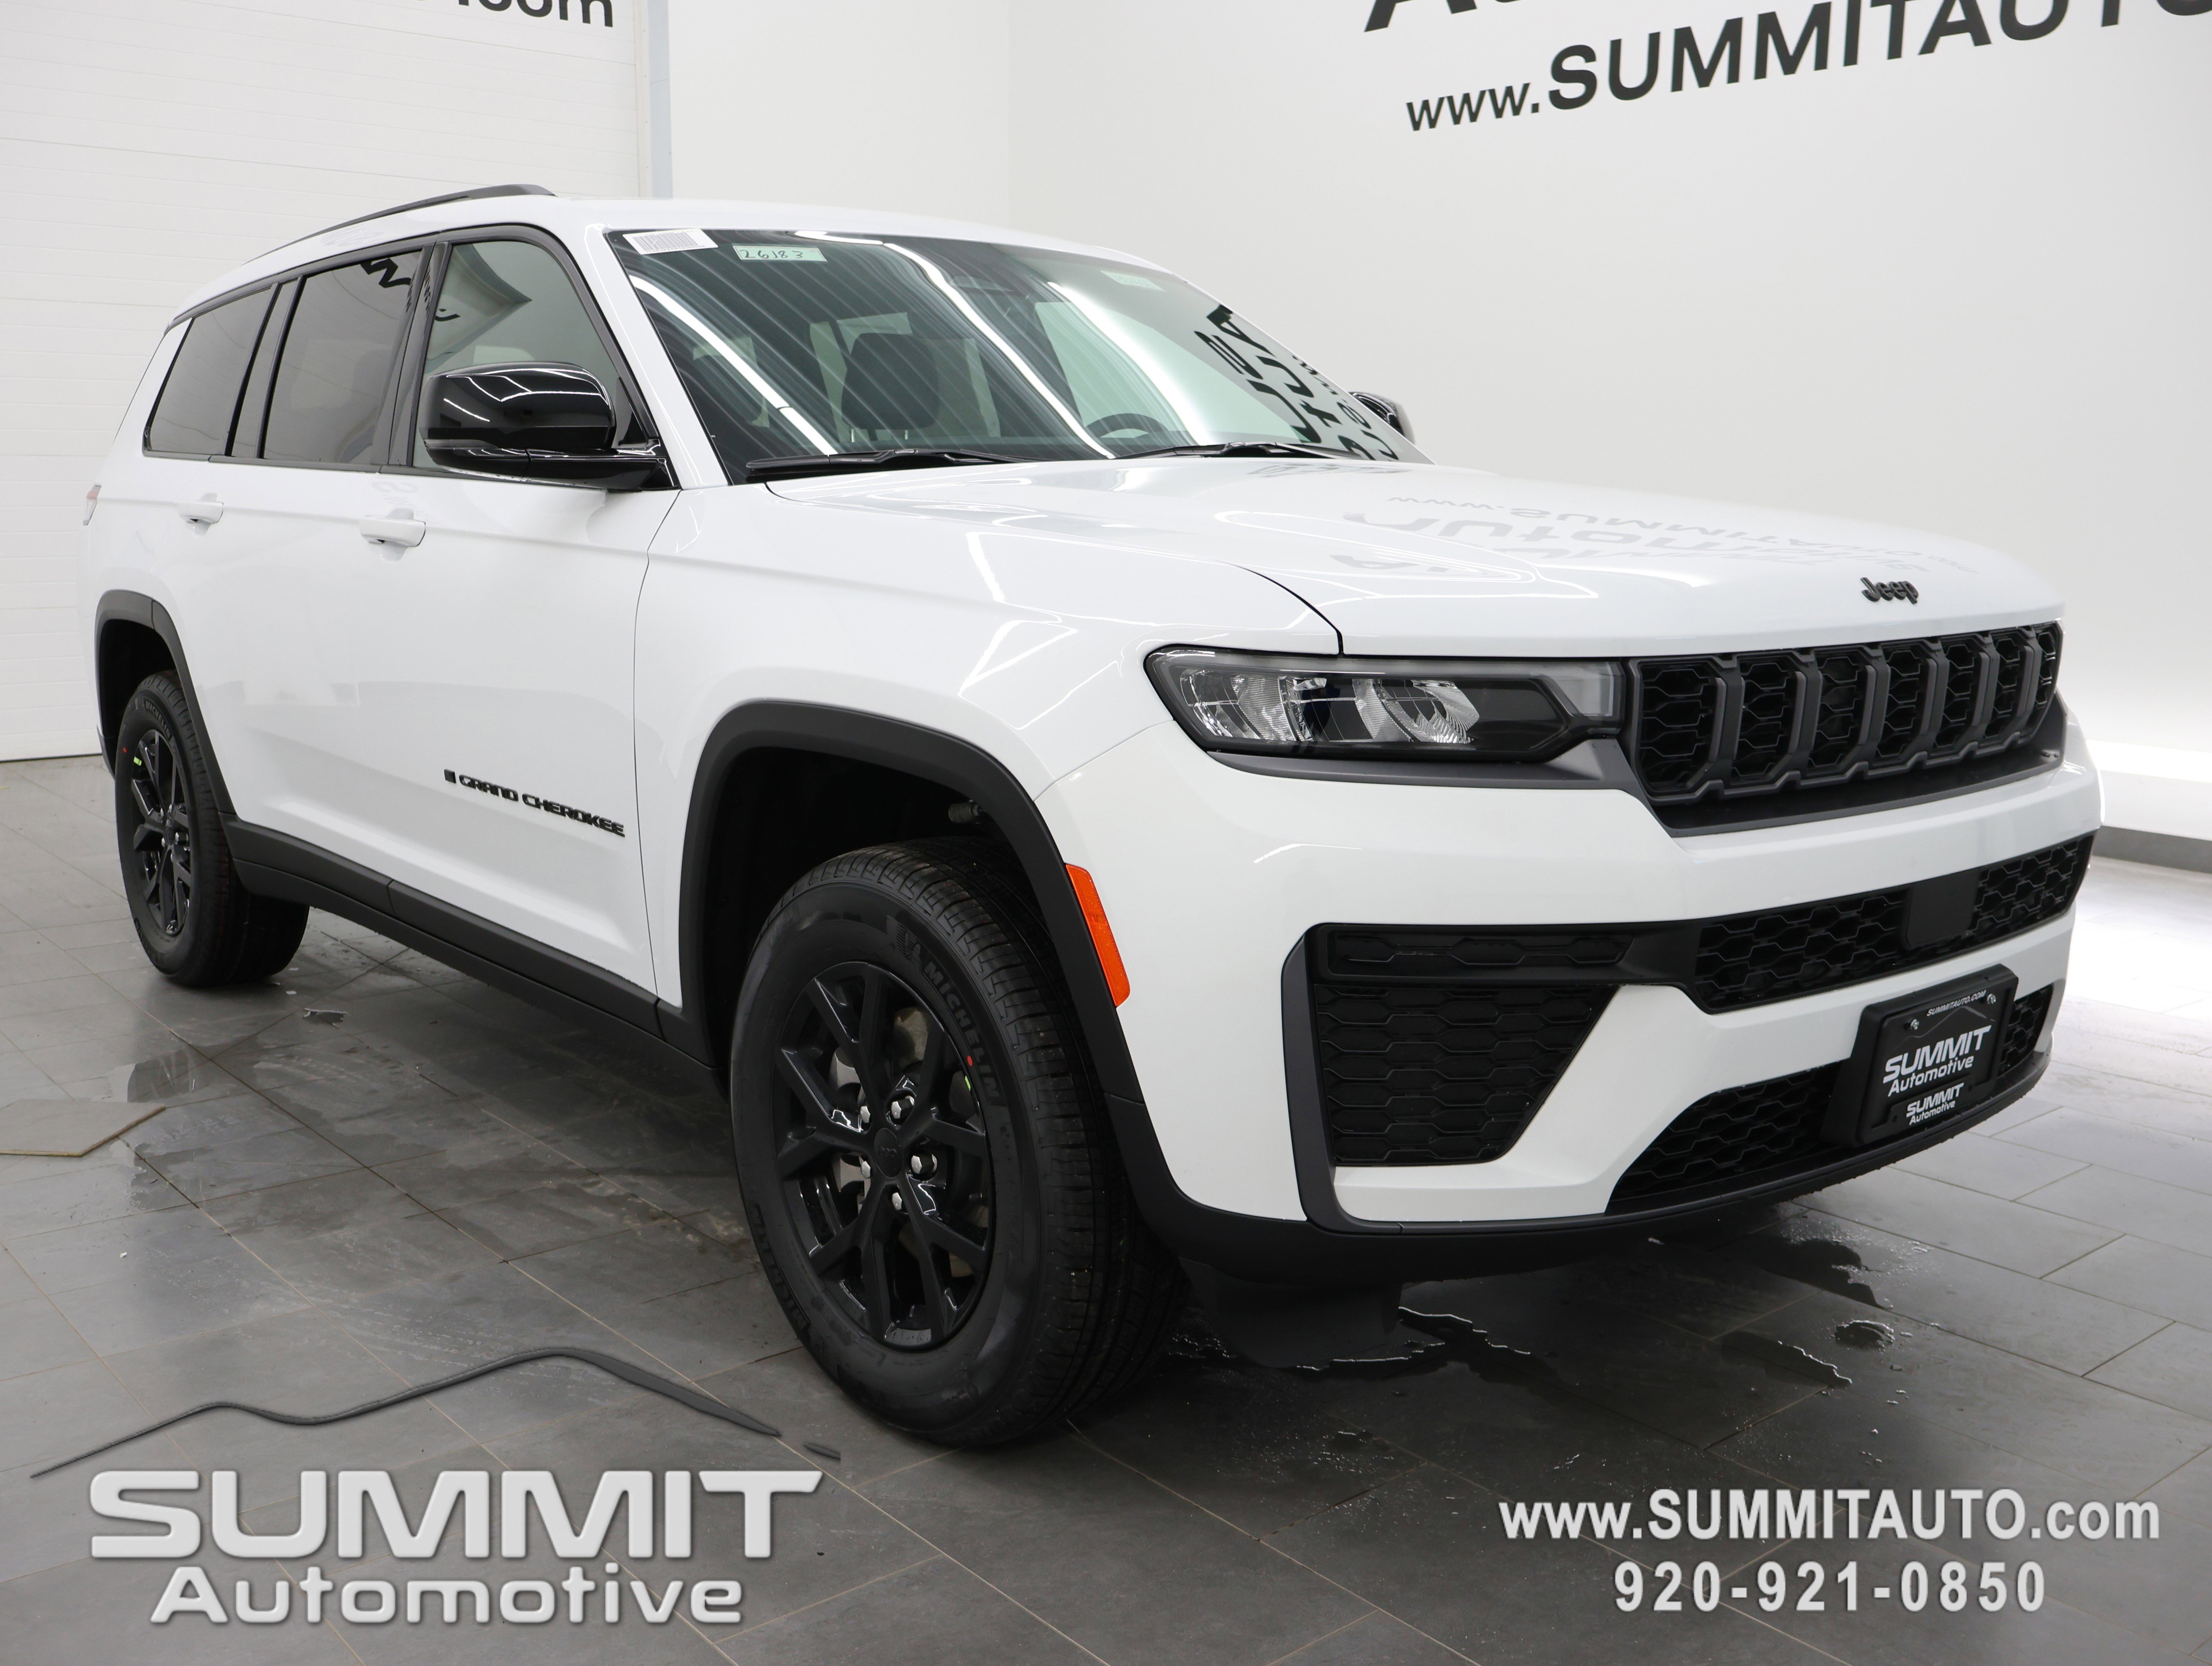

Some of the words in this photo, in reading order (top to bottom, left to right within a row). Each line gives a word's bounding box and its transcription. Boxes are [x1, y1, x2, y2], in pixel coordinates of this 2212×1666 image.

[1406, 0, 2212, 131] www.SUMMITAU
[739, 250, 803, 259] 26183
[1860, 577, 1919, 604] Jeep
[459, 775, 518, 801] GRAND
[522, 793, 625, 837] CHEROKEE
[1927, 990, 1986, 1017] SUMMITAUTO.COM
[924, 961, 999, 1097] MICHELIN
[1883, 1025, 1992, 1084] SUMMIT
[1888, 1056, 1974, 1096] Automotive
[1906, 1083, 1964, 1118] SUMMIT
[1909, 1100, 1956, 1125] Automotive
